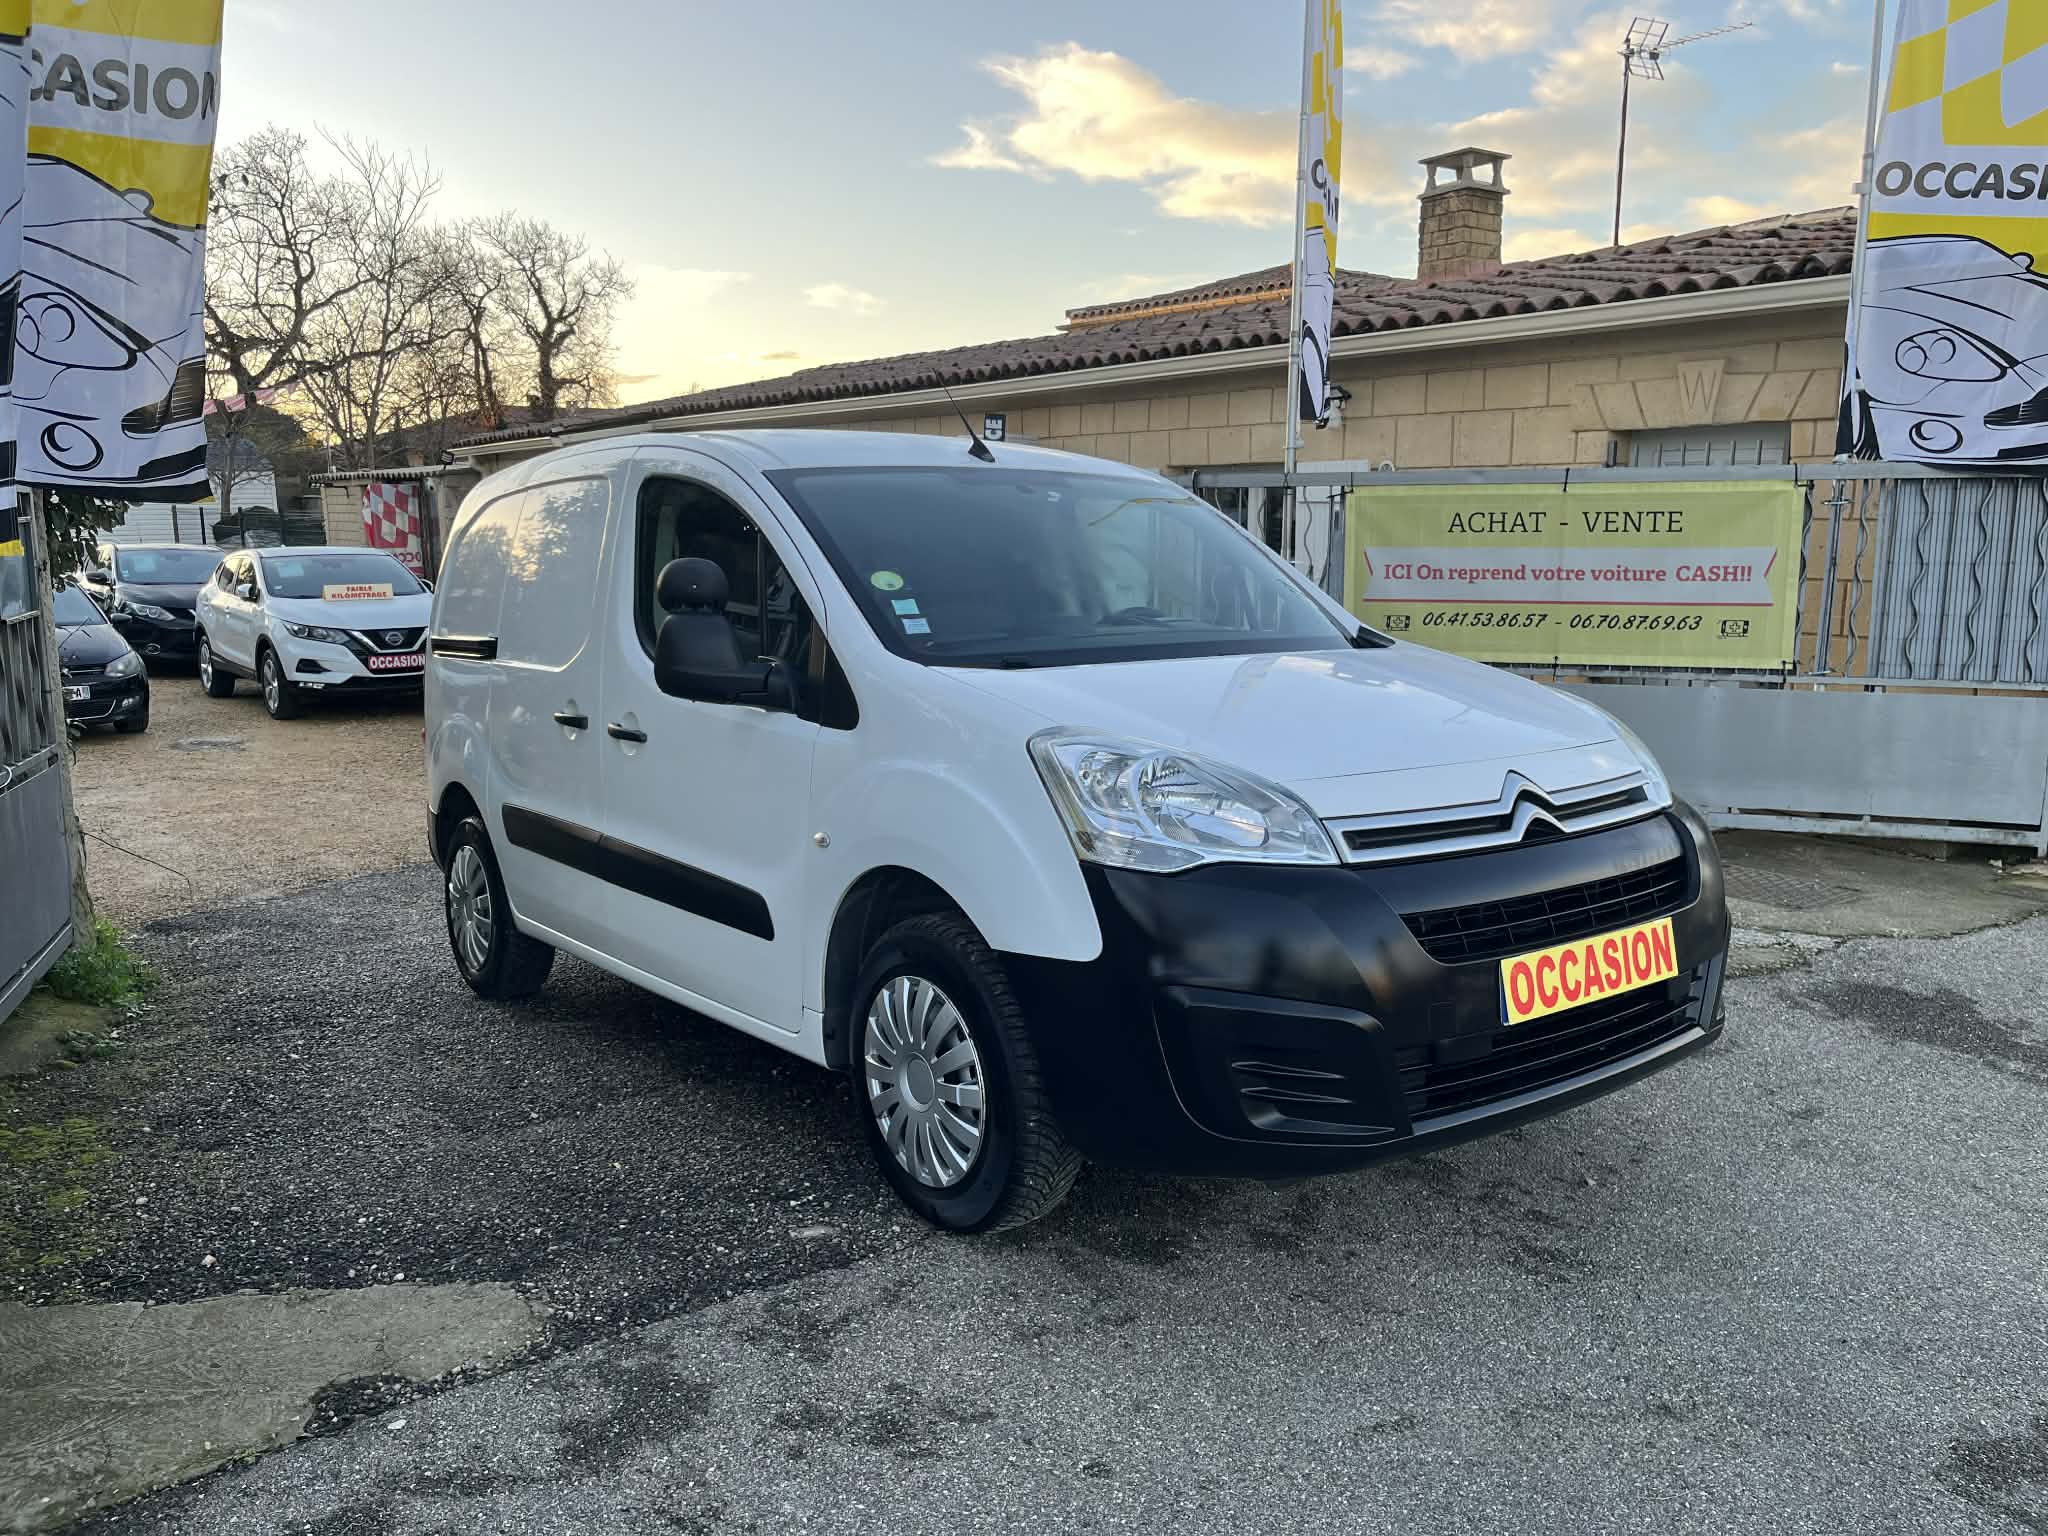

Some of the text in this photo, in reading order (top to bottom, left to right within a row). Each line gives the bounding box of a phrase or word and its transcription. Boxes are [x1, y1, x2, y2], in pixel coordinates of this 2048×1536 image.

[1448, 511, 1547, 533] ACHAT
[1582, 511, 1683, 533] VENTE
[1384, 564, 1752, 584] ICI On reprend votre voiture CASH!!
[1422, 611, 1549, 629] 06.41.53.86.57
[1570, 614, 1703, 631] 06.70.87.69.63
[369, 655, 426, 669] OCCASION
[1510, 925, 1673, 1015] OCCASION
